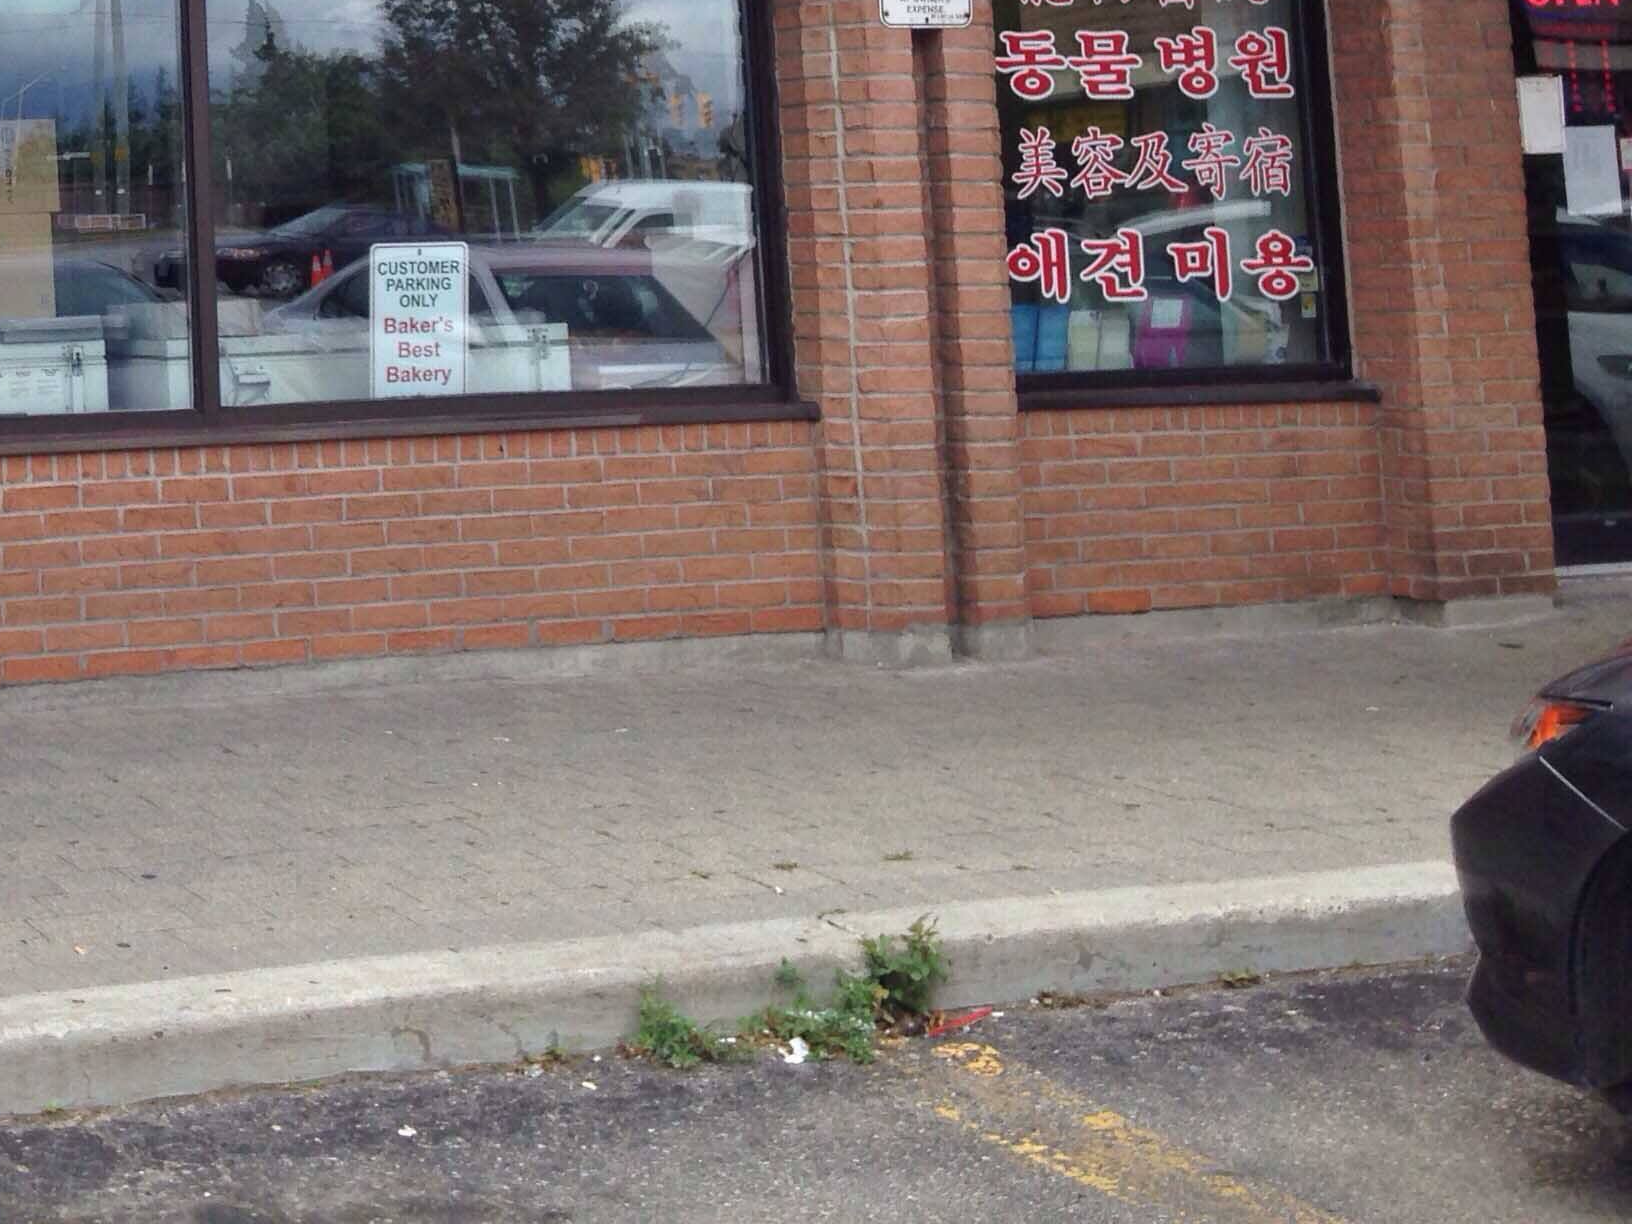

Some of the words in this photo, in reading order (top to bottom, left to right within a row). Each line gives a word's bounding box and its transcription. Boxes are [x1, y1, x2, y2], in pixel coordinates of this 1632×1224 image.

[1011, 123, 1294, 201] 美容及寄宿
[377, 260, 460, 276] CUSTOMER
[386, 277, 452, 291] PARKING
[399, 294, 439, 308] ONLY
[383, 317, 454, 334] Baker's
[398, 342, 440, 358] Best
[386, 366, 452, 386] Bakery
